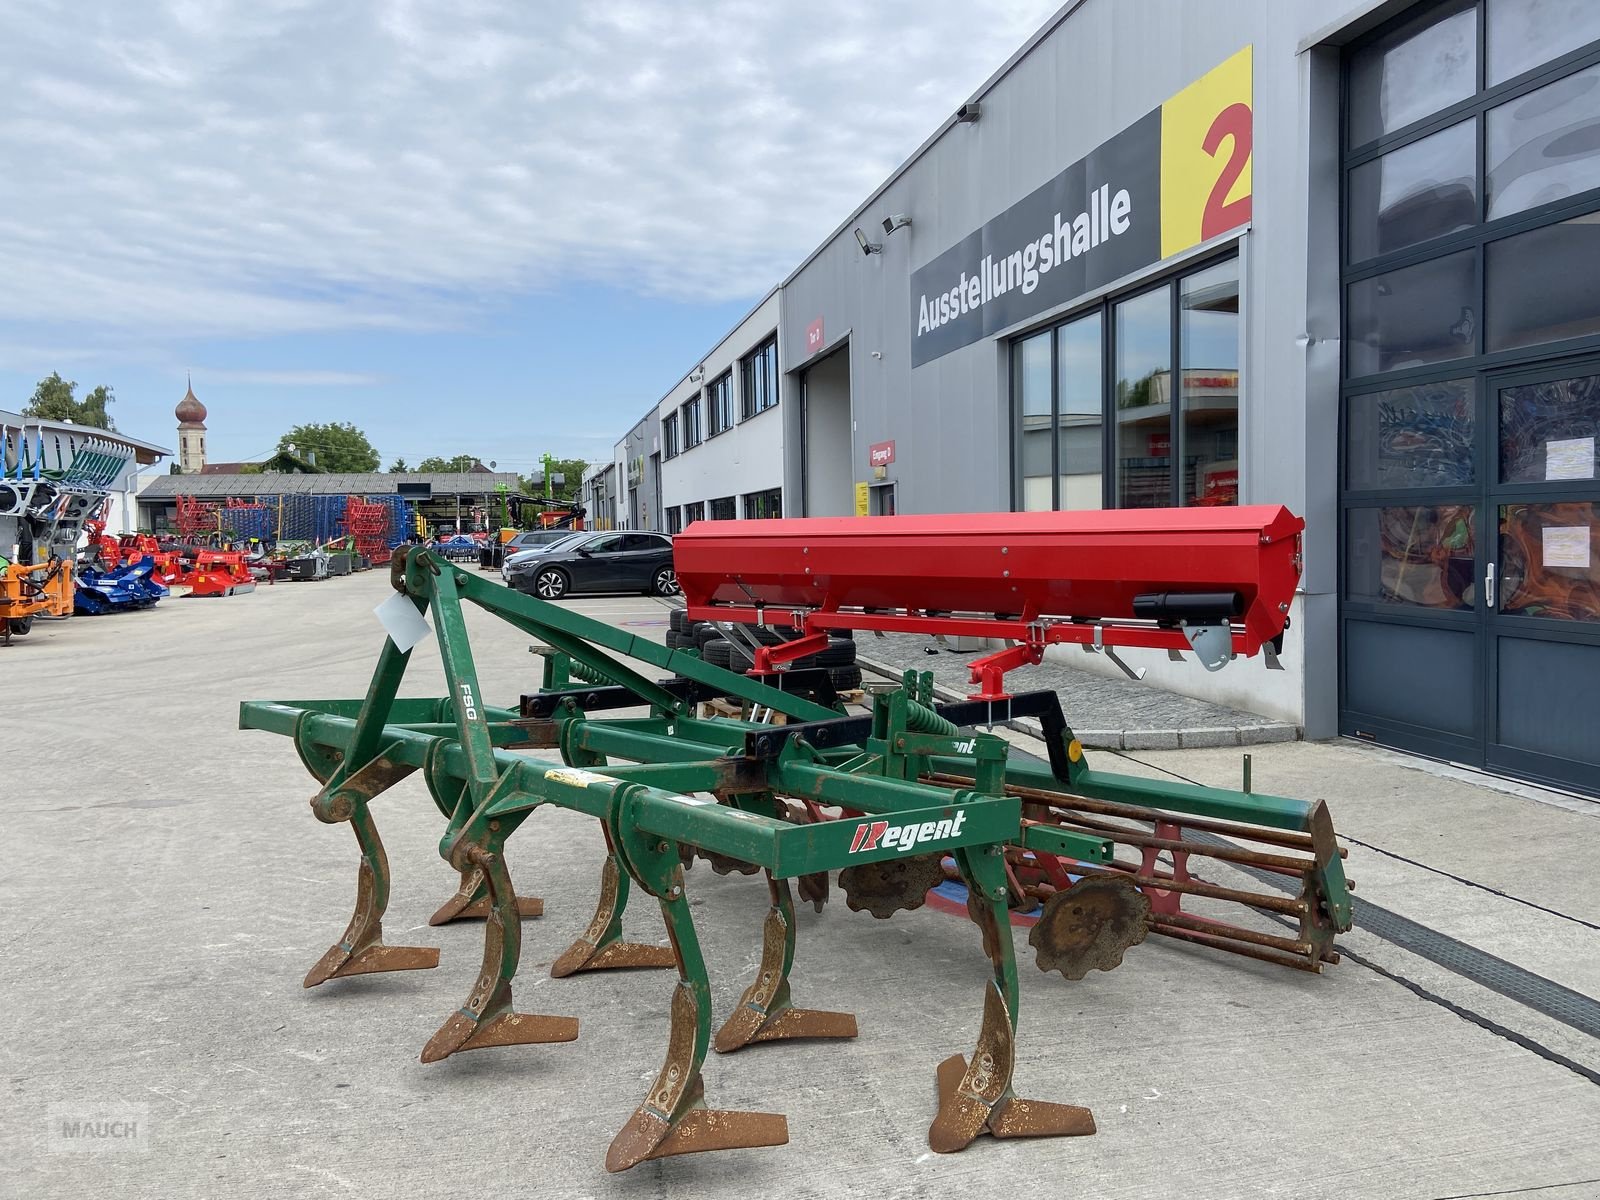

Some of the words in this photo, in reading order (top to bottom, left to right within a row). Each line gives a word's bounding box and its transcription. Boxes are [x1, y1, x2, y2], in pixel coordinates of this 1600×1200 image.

[917, 183, 1132, 337] Ausstellungshalle
[1201, 102, 1253, 243] 2
[460, 684, 478, 720] FSG
[848, 810, 967, 854] Regent
